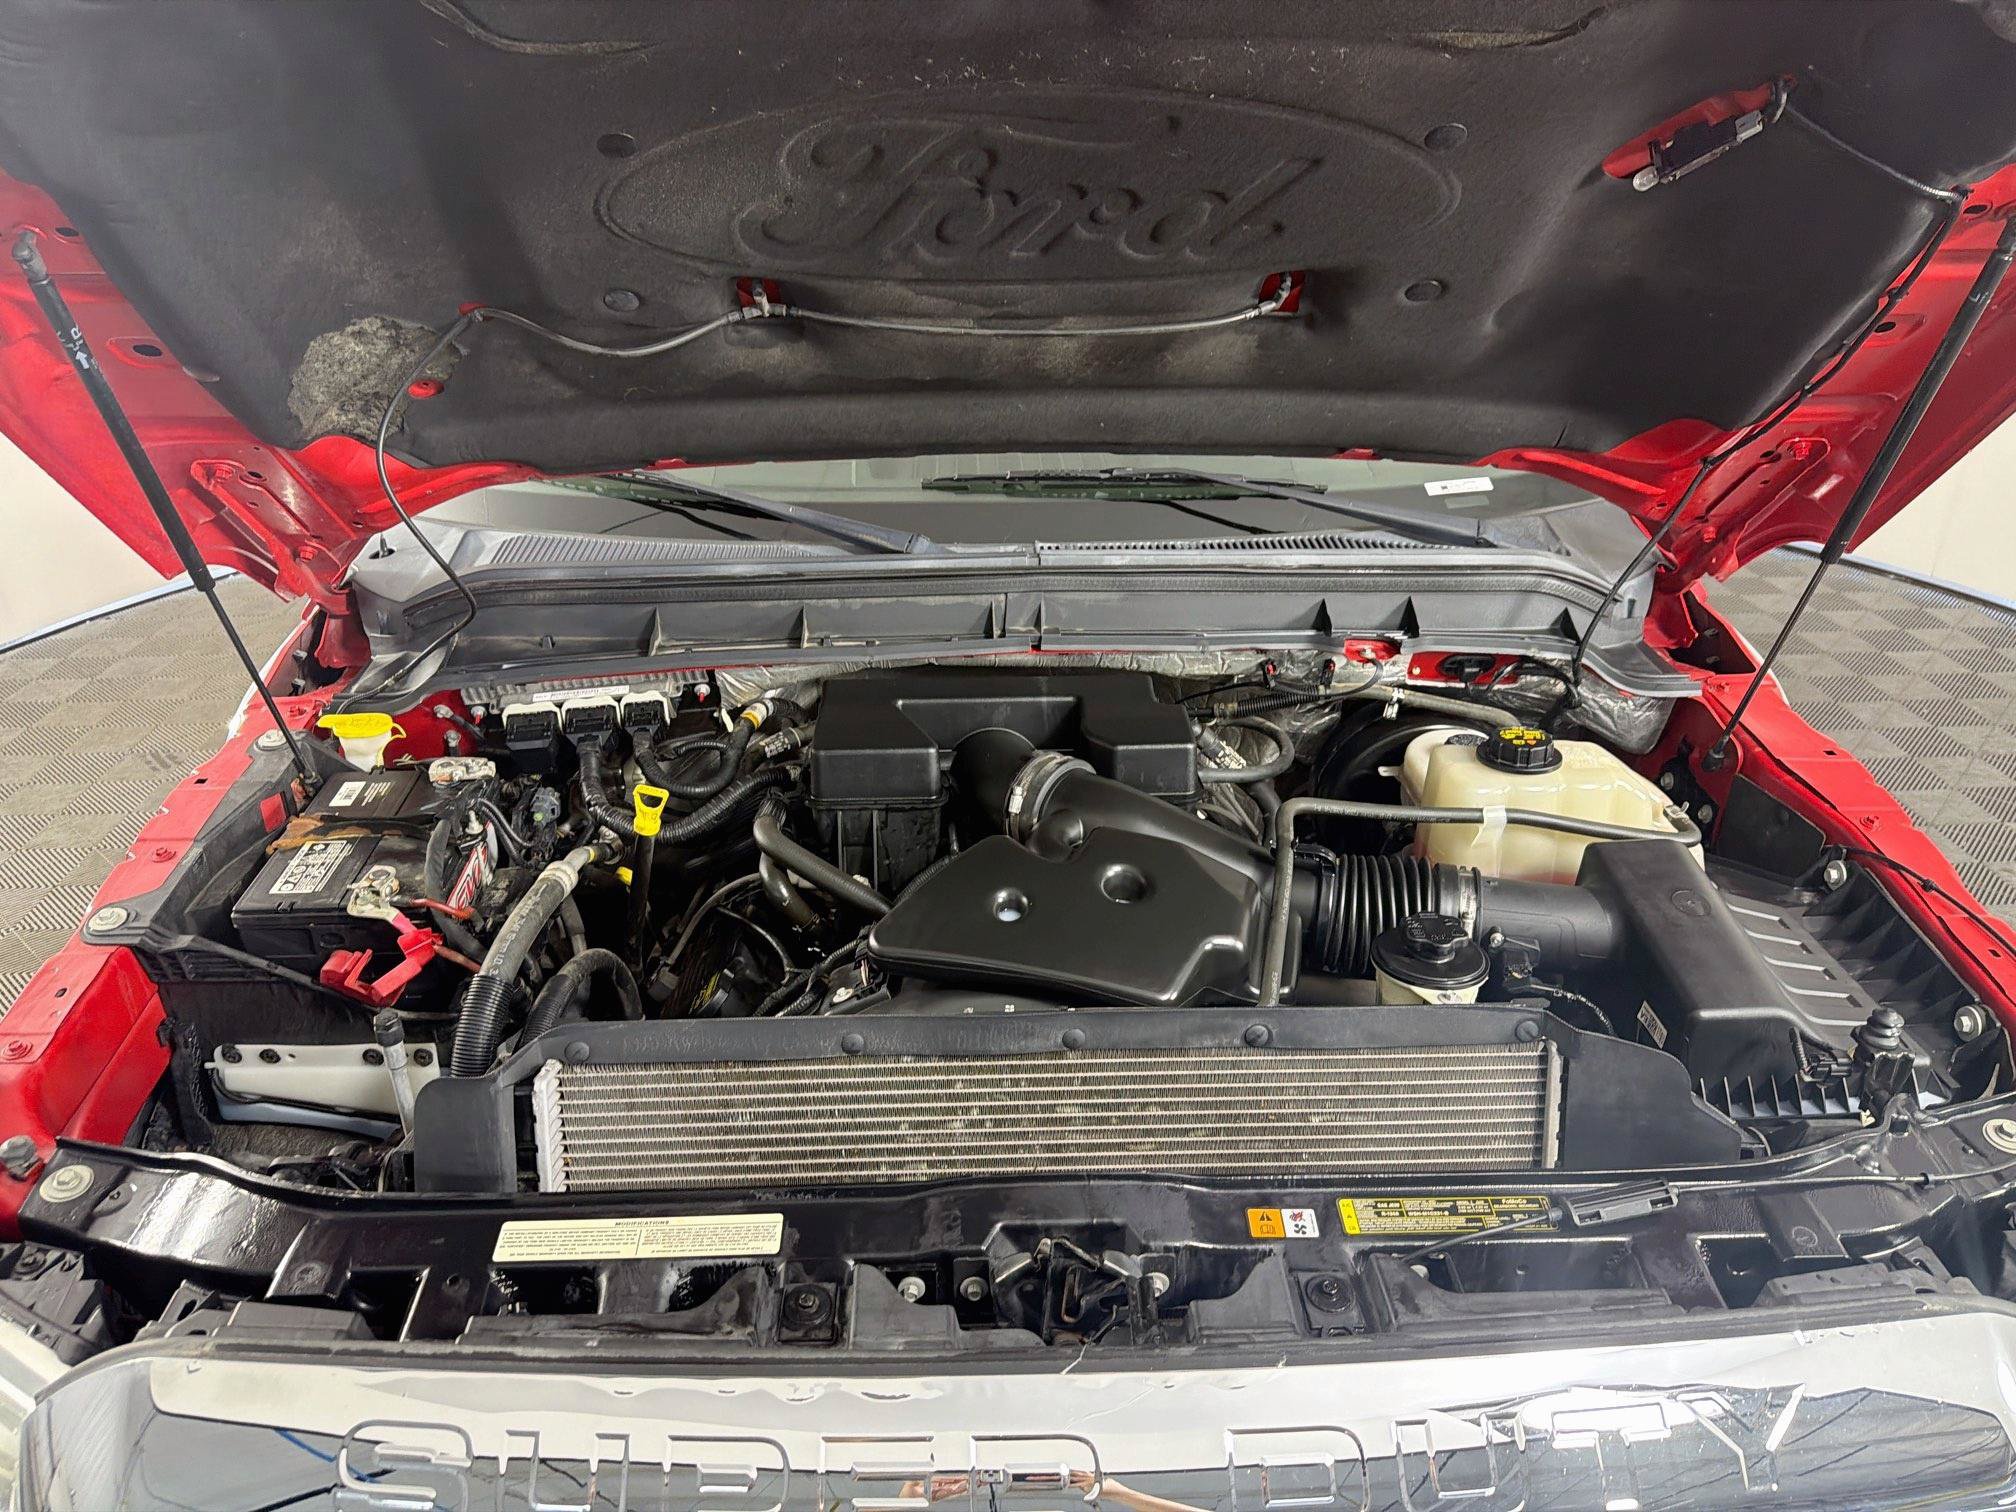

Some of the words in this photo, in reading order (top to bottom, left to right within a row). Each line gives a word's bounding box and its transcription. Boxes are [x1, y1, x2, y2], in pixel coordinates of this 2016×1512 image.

[735, 108, 1324, 264] Ford
[334, 1418, 1102, 1512] SUPER
[1224, 1381, 1806, 1512] DUTY
